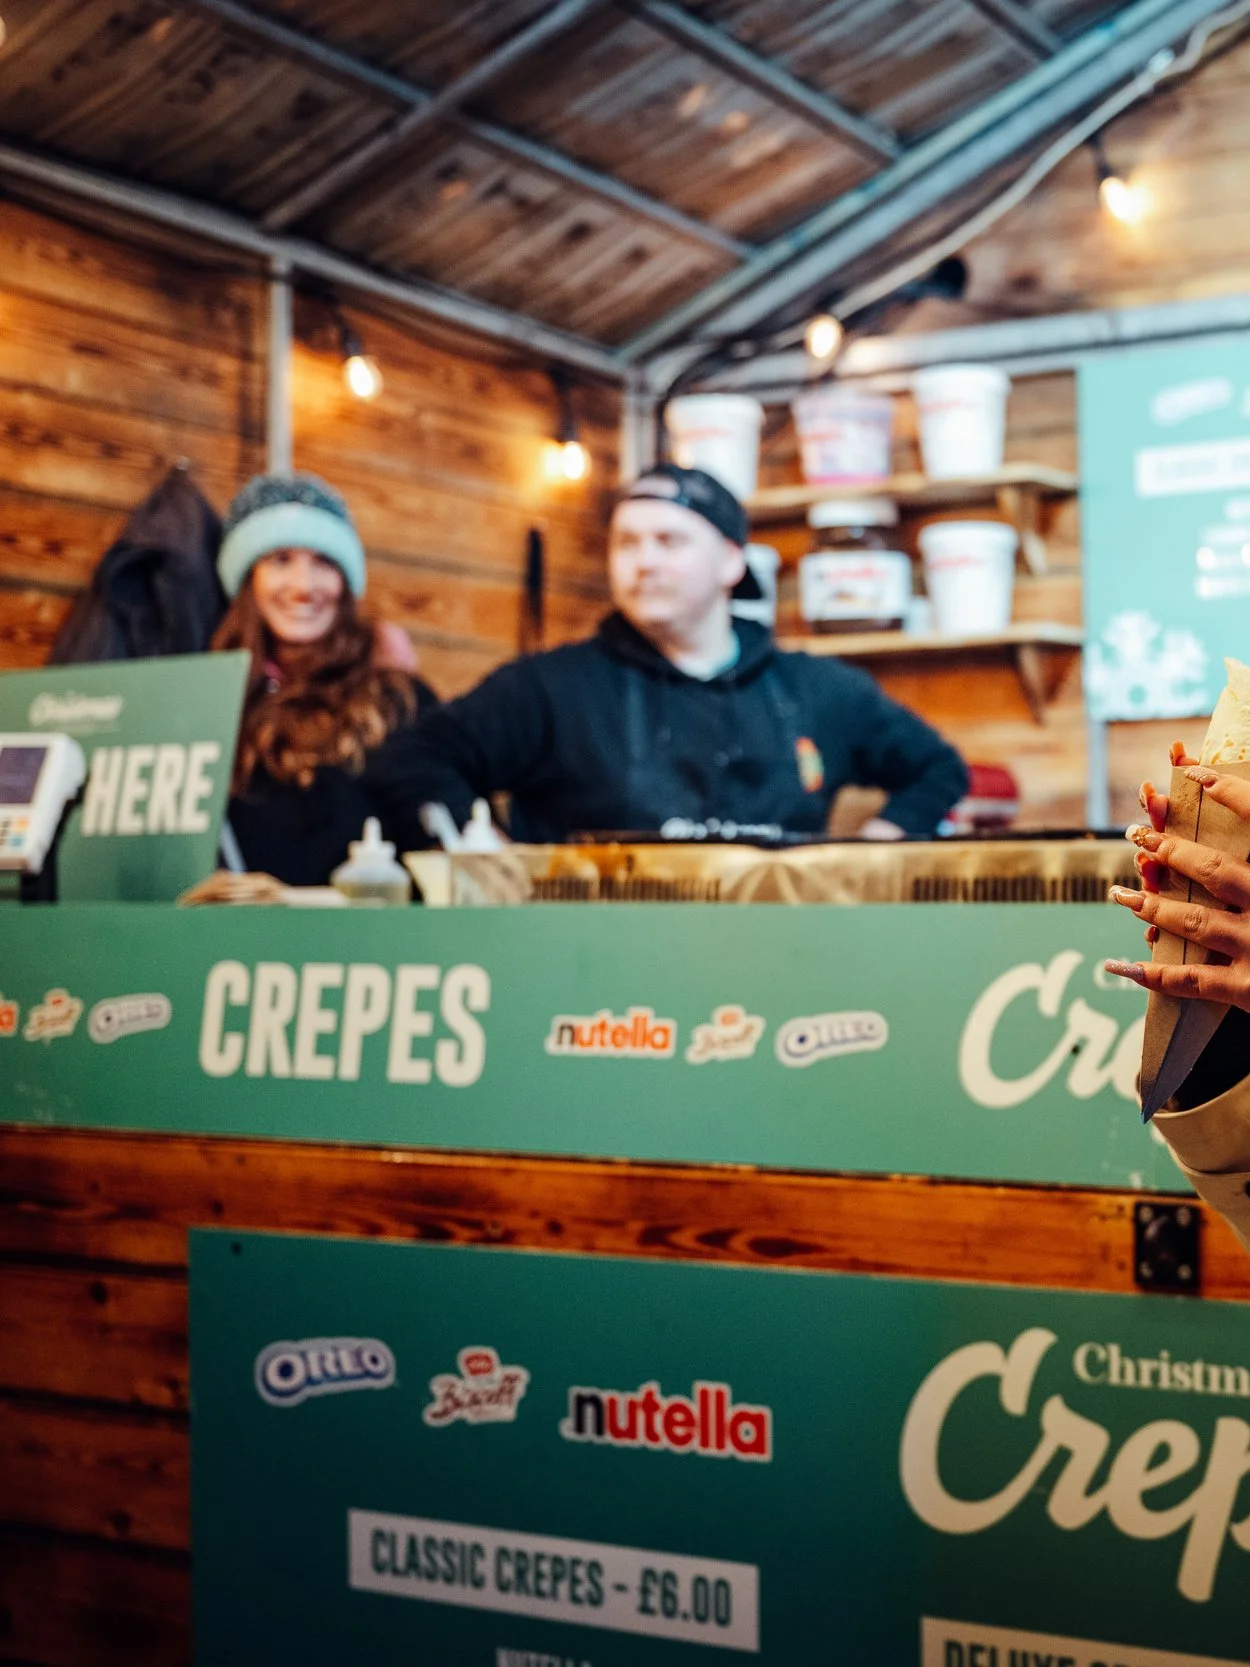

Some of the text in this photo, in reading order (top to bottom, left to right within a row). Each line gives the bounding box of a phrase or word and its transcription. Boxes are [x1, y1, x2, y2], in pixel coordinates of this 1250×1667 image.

[81, 741, 220, 837] HERE
[199, 959, 491, 1088] CREPES
[556, 1015, 671, 1050] nutella
[574, 1387, 767, 1455] nutella
[370, 1527, 486, 1591] CLASSIC
[494, 1545, 605, 1609] CREPES
[637, 1566, 733, 1629] £6.00
